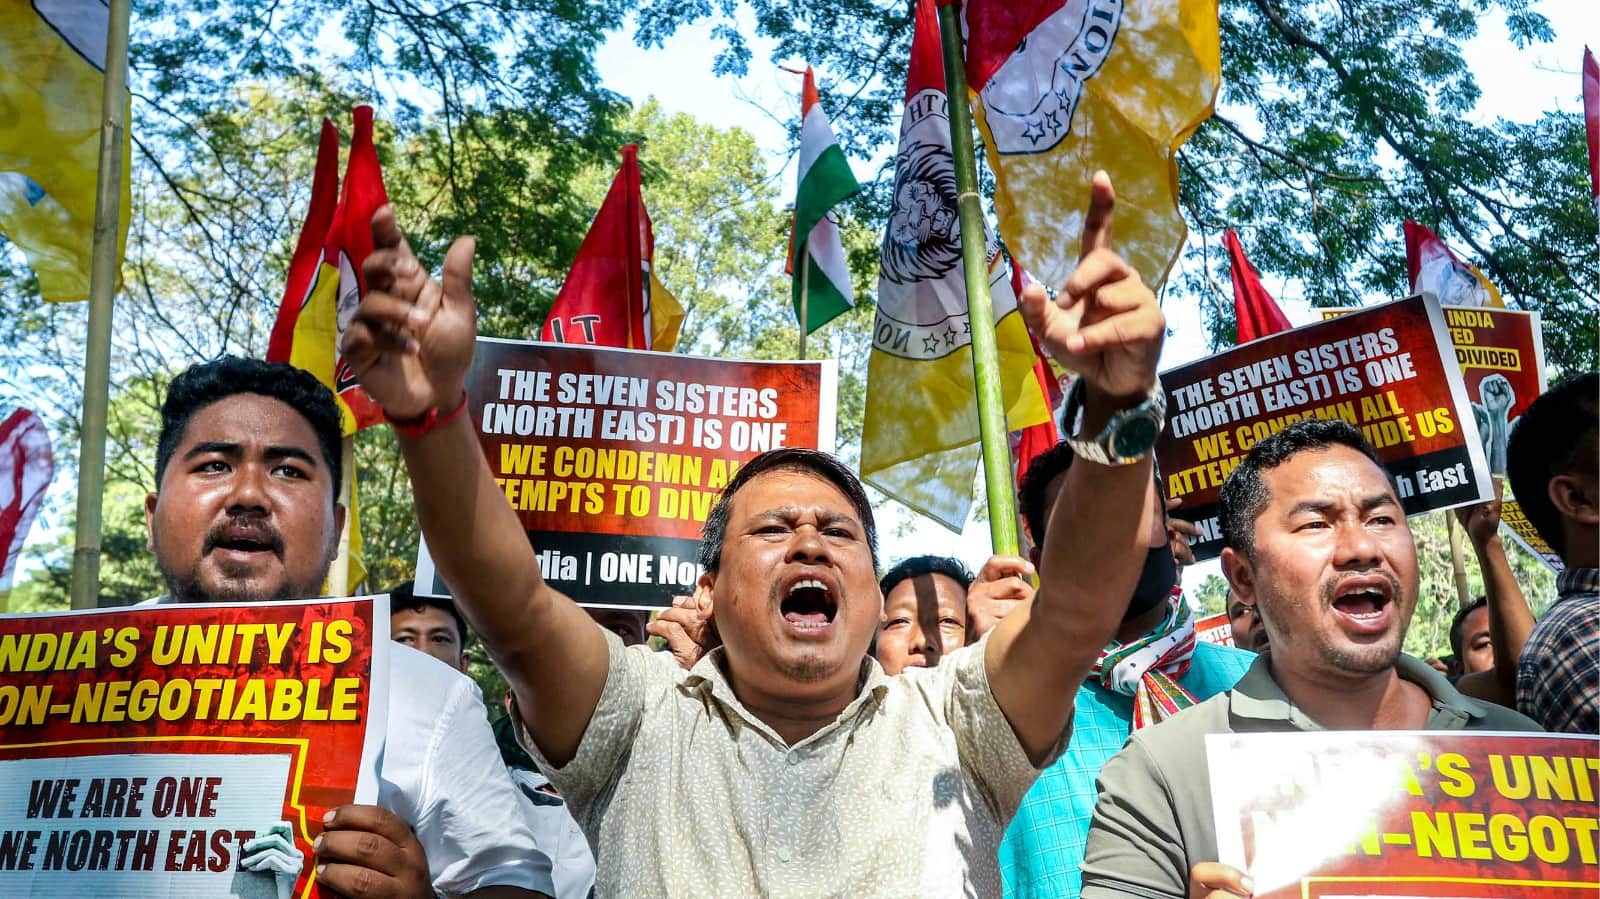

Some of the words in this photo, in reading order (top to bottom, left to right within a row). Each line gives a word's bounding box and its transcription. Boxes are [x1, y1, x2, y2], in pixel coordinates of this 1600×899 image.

[1448, 310, 1495, 328] INDIA
[1171, 378, 1216, 411] THE
[1218, 354, 1293, 396] SEVEN
[1294, 327, 1399, 375] SISTERS
[1456, 348, 1518, 368] DIVIDED
[498, 369, 551, 402] THE
[557, 373, 649, 408] SEVEN
[656, 380, 778, 419] SISTERS
[1171, 392, 1260, 439] (NORTH
[1261, 374, 1333, 412] EAST)
[1334, 367, 1363, 395] IS
[1365, 352, 1417, 387] ONE
[482, 404, 594, 439] (NORTH
[600, 409, 684, 446] EAST)
[693, 419, 722, 449] IS
[730, 422, 787, 452] ONE
[1193, 431, 1234, 462] WE
[1360, 390, 1405, 422] ALL
[1416, 407, 1455, 438] US
[500, 444, 547, 476] WE
[554, 446, 702, 486] CONDEMN
[611, 484, 648, 517] TO
[1186, 515, 1225, 546] NE
[1416, 462, 1469, 494] East
[536, 550, 578, 581] dia
[600, 552, 652, 584] ONE
[0, 626, 138, 672] NDIA'S
[151, 622, 297, 665] UNITY
[307, 620, 354, 664] IS
[0, 677, 361, 726] ON-NEGOTIABLE
[27, 779, 80, 818] WE
[80, 777, 147, 818] ARE
[152, 776, 222, 818] ONE
[0, 830, 42, 871] NE
[42, 829, 160, 871] NORTH
[164, 829, 256, 872] EAST
